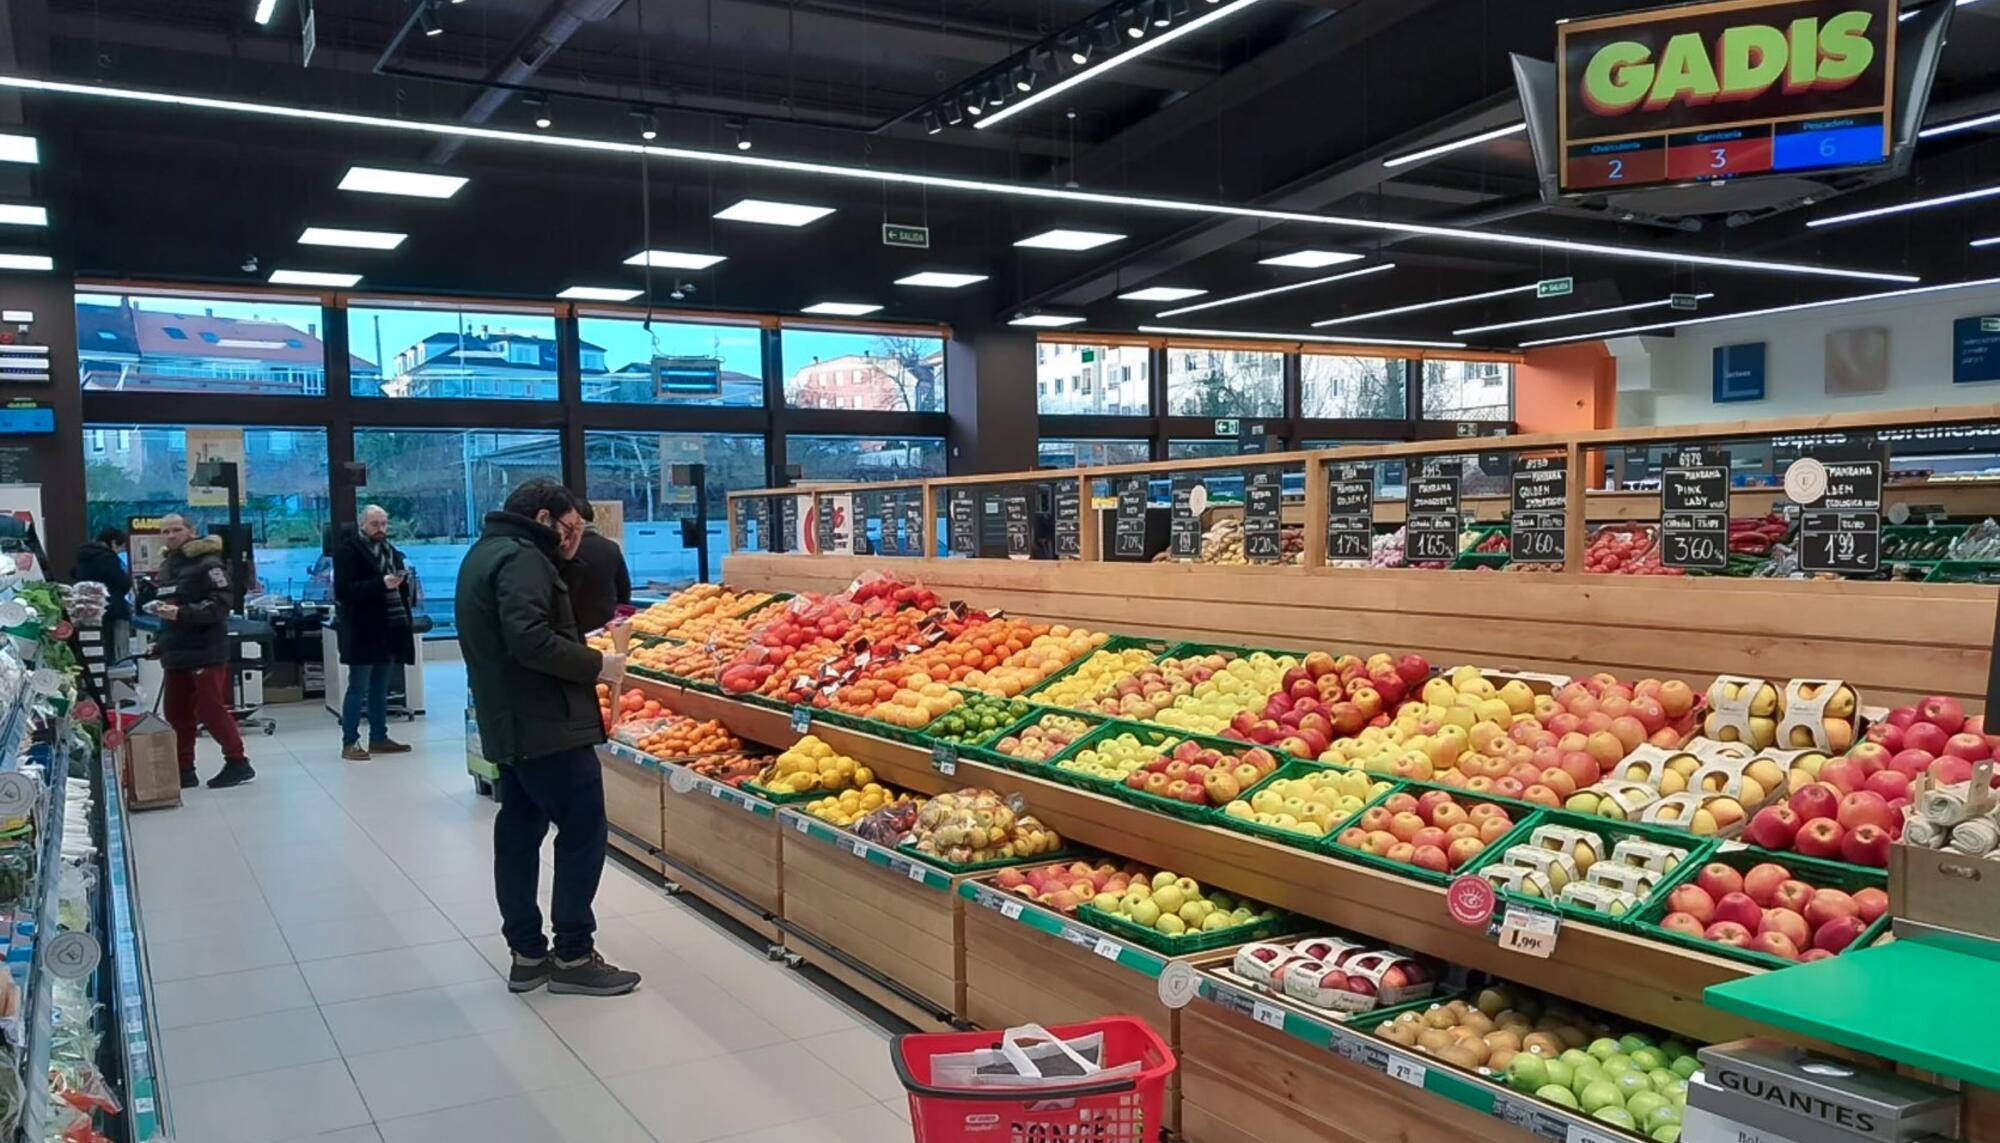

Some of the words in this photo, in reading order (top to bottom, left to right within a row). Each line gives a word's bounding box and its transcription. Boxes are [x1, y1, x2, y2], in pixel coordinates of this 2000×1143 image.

[1583, 11, 1874, 112] GADIS
[1820, 138, 1836, 156] 6
[1711, 148, 1727, 168] 3
[1608, 160, 1623, 178] 2
[1674, 484, 1702, 495] PINK
[1684, 496, 1708, 506] LADY
[1718, 1070, 1875, 1132] GUANTES
